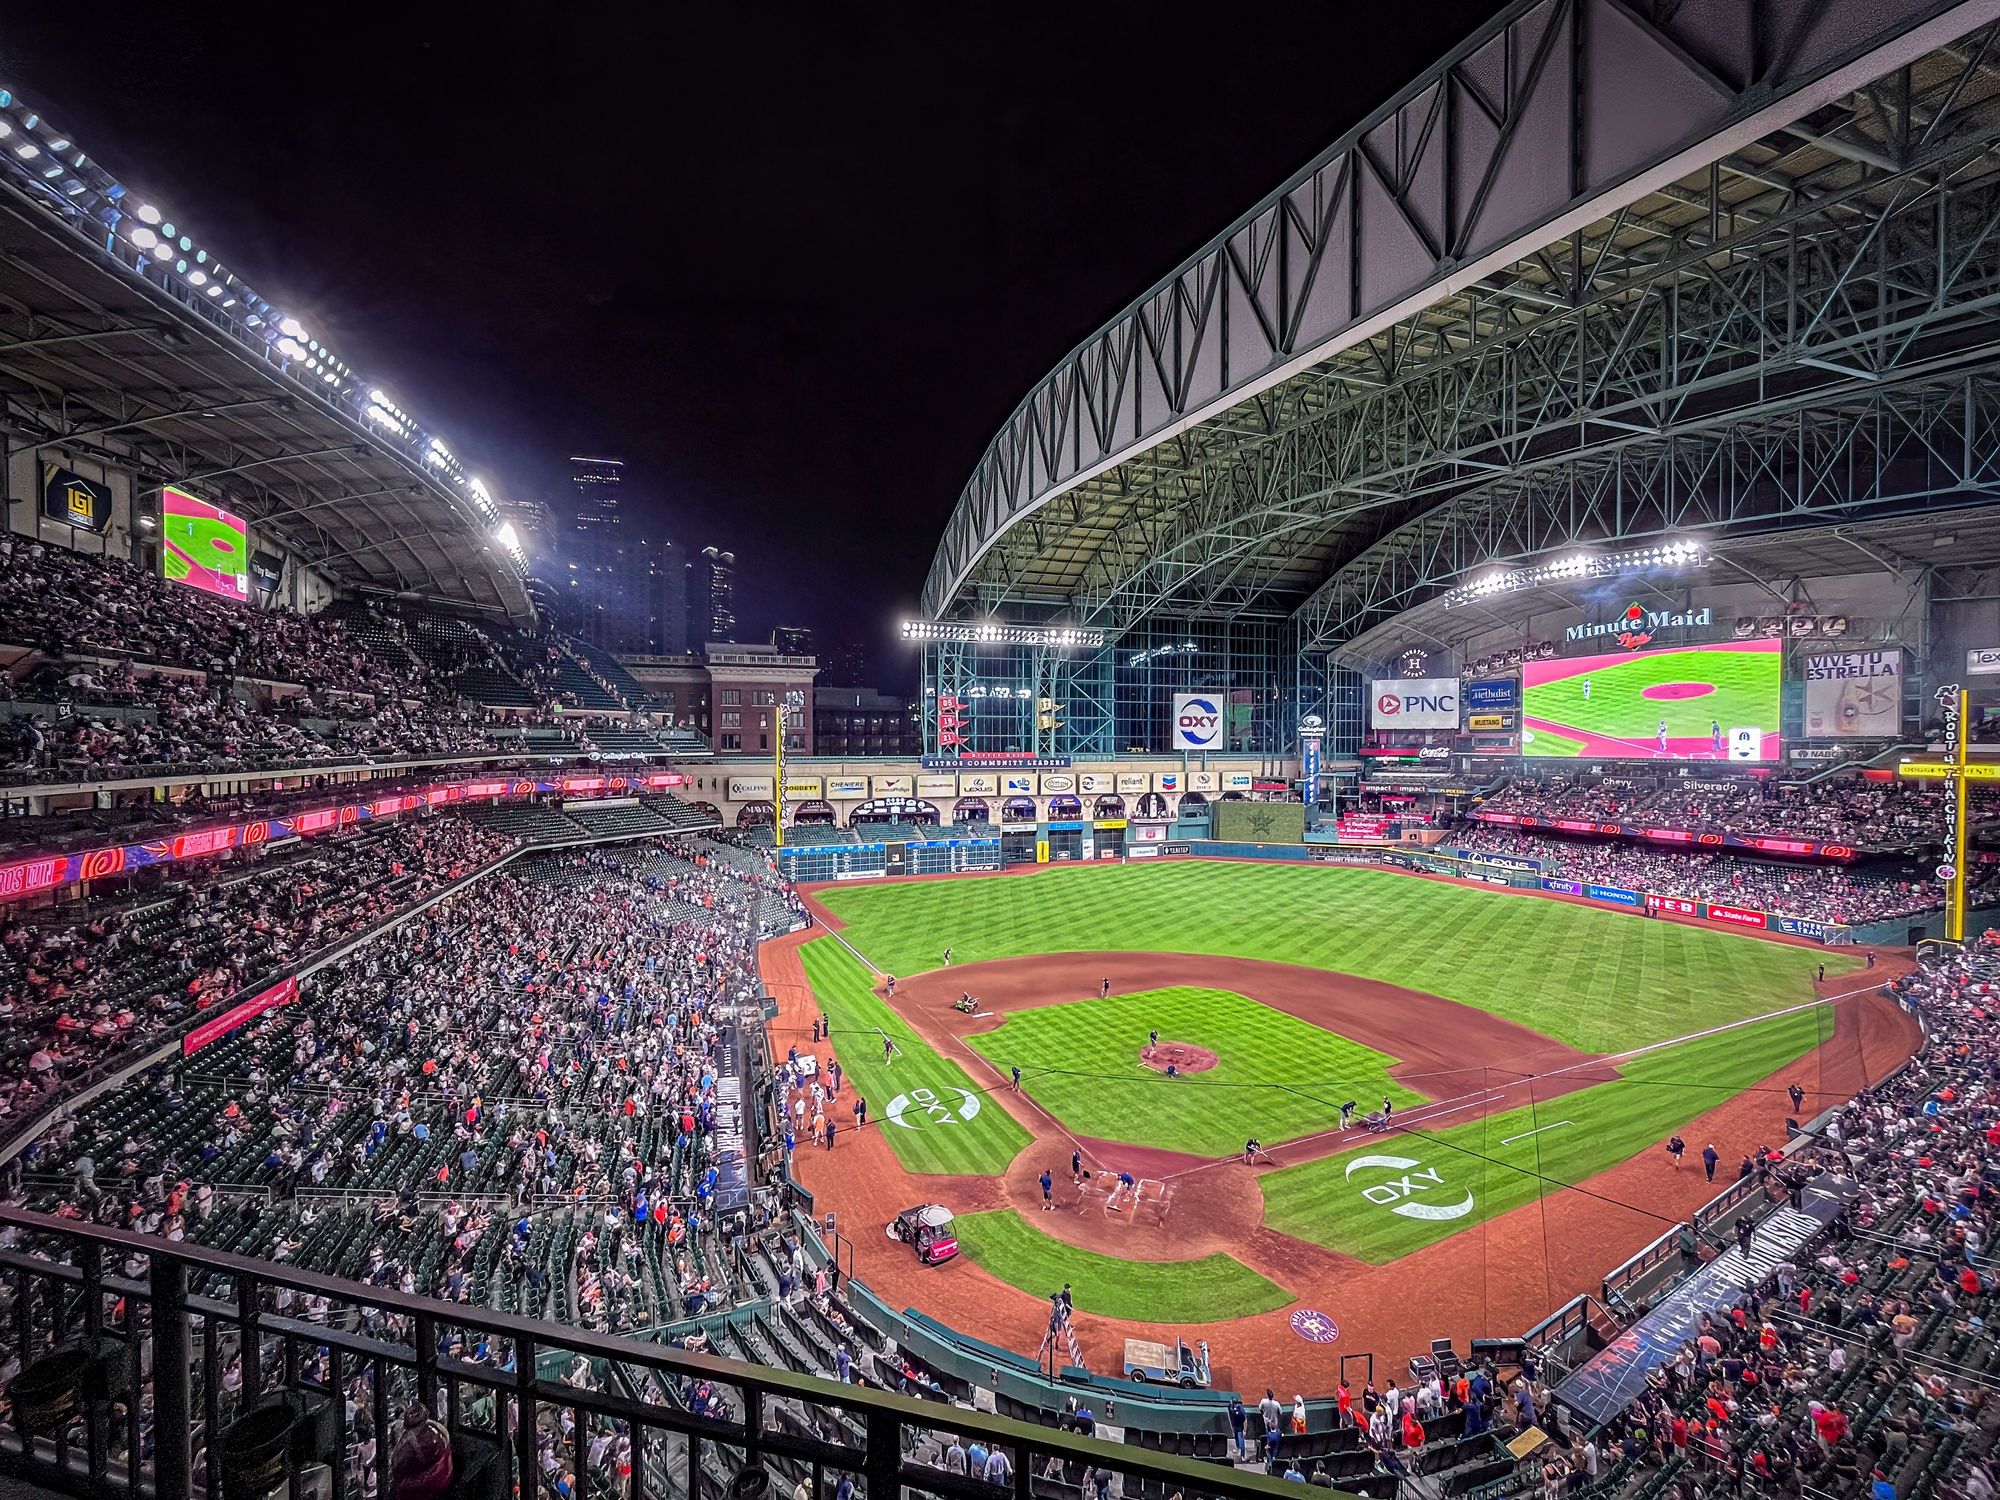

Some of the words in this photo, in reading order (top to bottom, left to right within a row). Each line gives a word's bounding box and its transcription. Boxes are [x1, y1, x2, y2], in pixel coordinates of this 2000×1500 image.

[1566, 618, 1642, 642] Minute
[1647, 608, 1711, 628] Maid
[1409, 658, 1421, 669] H
[1860, 652, 1882, 664] TU
[1472, 689, 1511, 699] Methodist
[1403, 695, 1454, 712] PNC
[943, 717, 952, 725] 19
[1179, 715, 1218, 728] OXY
[1944, 712, 1957, 751] ROOT
[1420, 747, 1450, 758] Coca-Cola
[1017, 778, 1030, 786] slb
[1121, 778, 1143, 786] reliant
[1602, 777, 1632, 787] Chevy
[1683, 781, 1738, 792] Silverado
[745, 806, 775, 814] MAVEN
[1943, 804, 1956, 863] CHIKIN
[1484, 856, 1529, 869] LEXUS
[1548, 880, 1574, 892] xfinity
[1600, 891, 1635, 901] HONDA
[1648, 897, 1693, 913] H-E-B
[1723, 911, 1742, 921] State
[1742, 914, 1761, 924] Farm
[1797, 921, 1822, 931] ENER
[1798, 927, 1822, 937] TRAN
[717, 1078, 741, 1103] MINUTE
[910, 1088, 959, 1125] OXY
[717, 1130, 744, 1152] PARK
[1361, 1167, 1445, 1205] OXY
[1757, 1207, 1822, 1258] ASTROS
[1652, 1314, 1691, 1344] HOME
